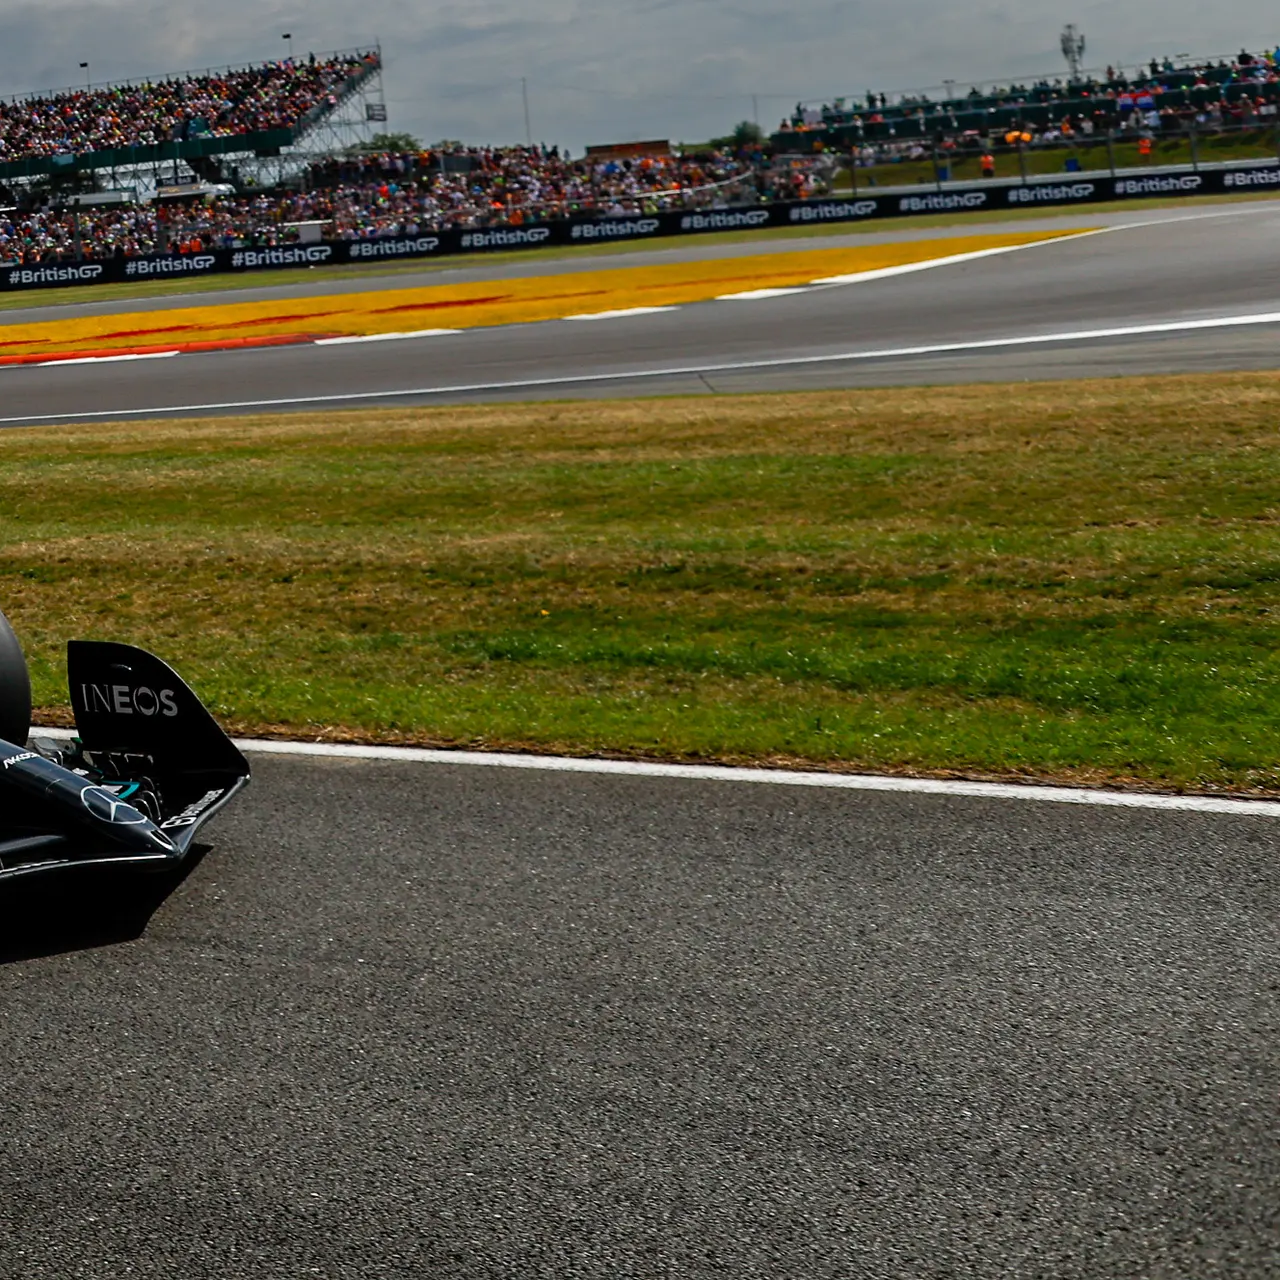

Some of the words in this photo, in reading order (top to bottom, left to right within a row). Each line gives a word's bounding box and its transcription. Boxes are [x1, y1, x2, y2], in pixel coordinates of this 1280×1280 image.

[1008, 184, 1094, 202] #BritishGP
[1114, 176, 1202, 193] #BritishGP
[790, 201, 877, 220] #BritishGP
[899, 193, 986, 211] #BritishGP
[571, 219, 659, 238] #BritishGP
[682, 210, 769, 229] #BritishGP
[350, 237, 439, 257] #BritishGP
[461, 228, 550, 247] #BritishGP
[126, 256, 215, 274] #BritishGP
[232, 246, 331, 267] #BritishGP
[9, 265, 102, 285] #BritishGP
[80, 683, 179, 717] INEOS
